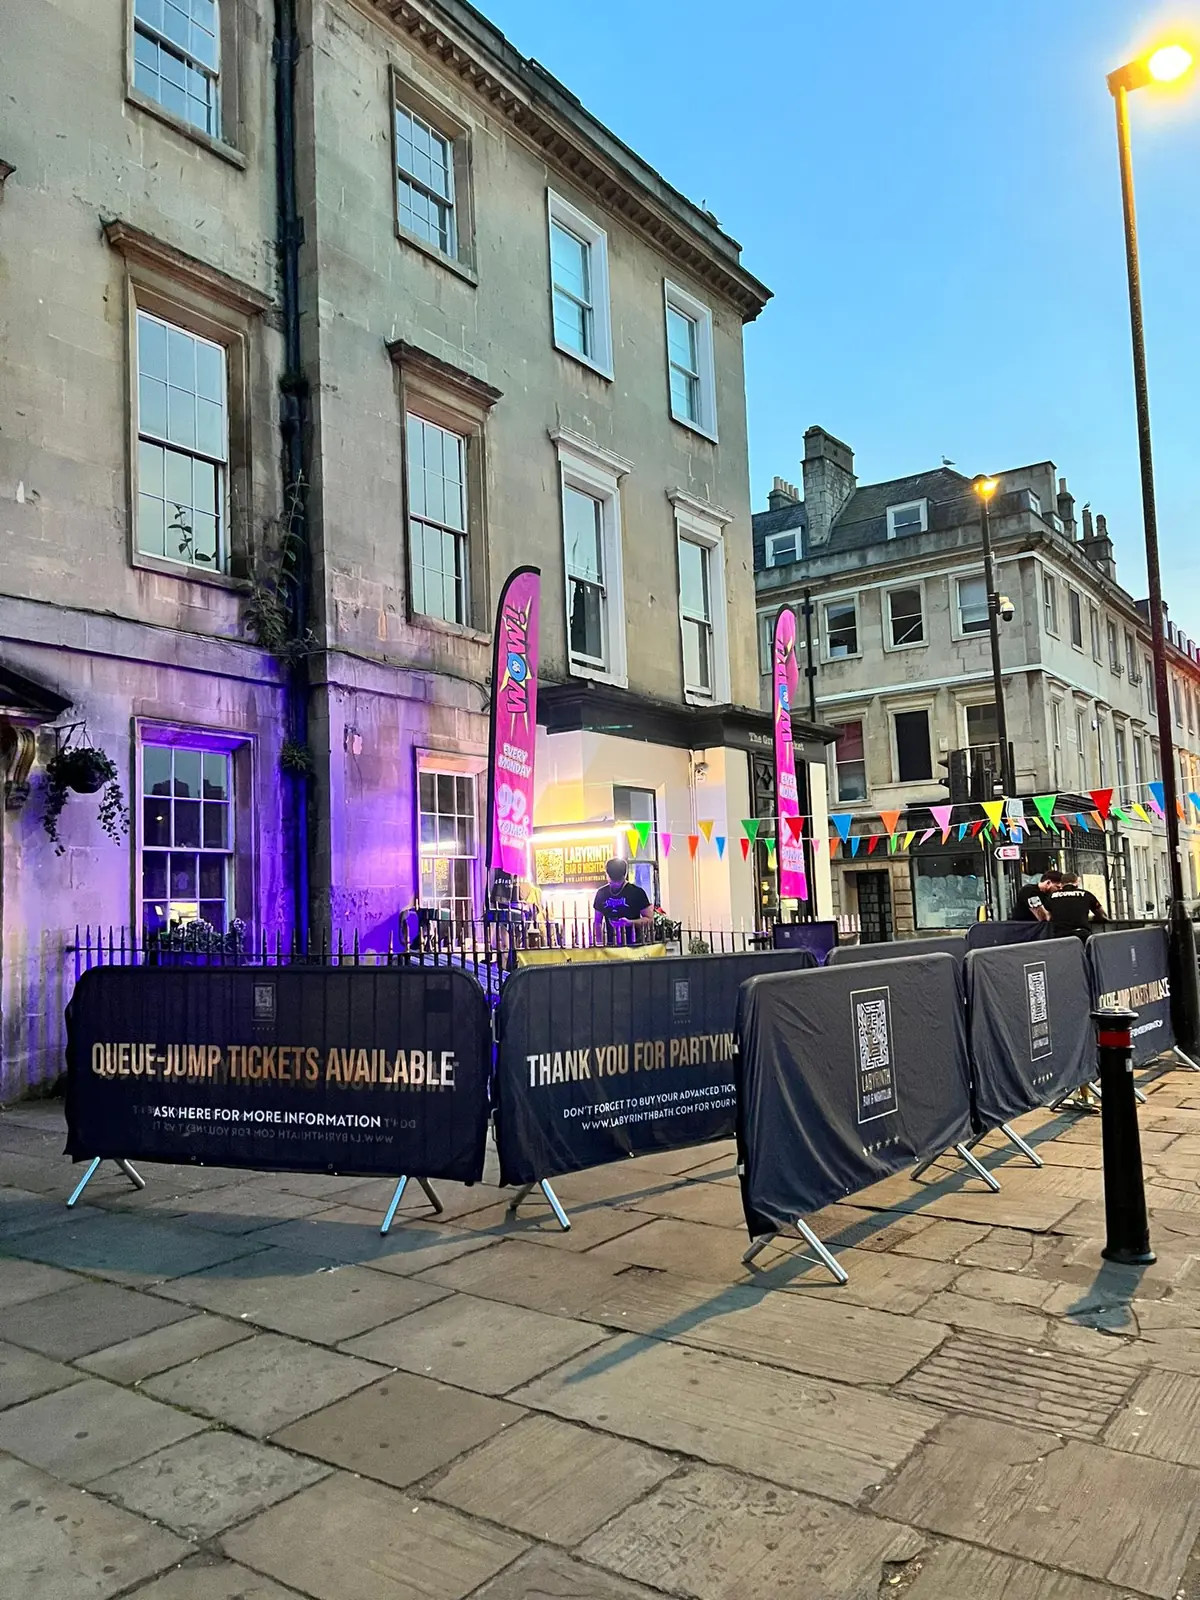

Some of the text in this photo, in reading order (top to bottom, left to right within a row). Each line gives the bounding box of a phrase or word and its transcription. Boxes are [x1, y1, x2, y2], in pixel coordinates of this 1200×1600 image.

[749, 732, 762, 743] The
[499, 756, 531, 778] MONDAY
[564, 844, 613, 863] LABYRINTH
[1051, 890, 1085, 899] SECURITY
[92, 1042, 455, 1086] QUEUE-JUMP TICKETS AVAILABLE
[527, 1033, 733, 1087] THANK YOU FOR PARTYIN
[563, 1083, 736, 1119] DON'T FORGET TO BUY YOUR ADVANCED TICK
[154, 1106, 381, 1127] ASK HERE FOR MORE INFORMATION
[581, 1105, 693, 1131] WWW.LABYRINTHBATH.COM
[694, 1101, 709, 1112] FOR
[710, 1098, 730, 1109] YOUR
